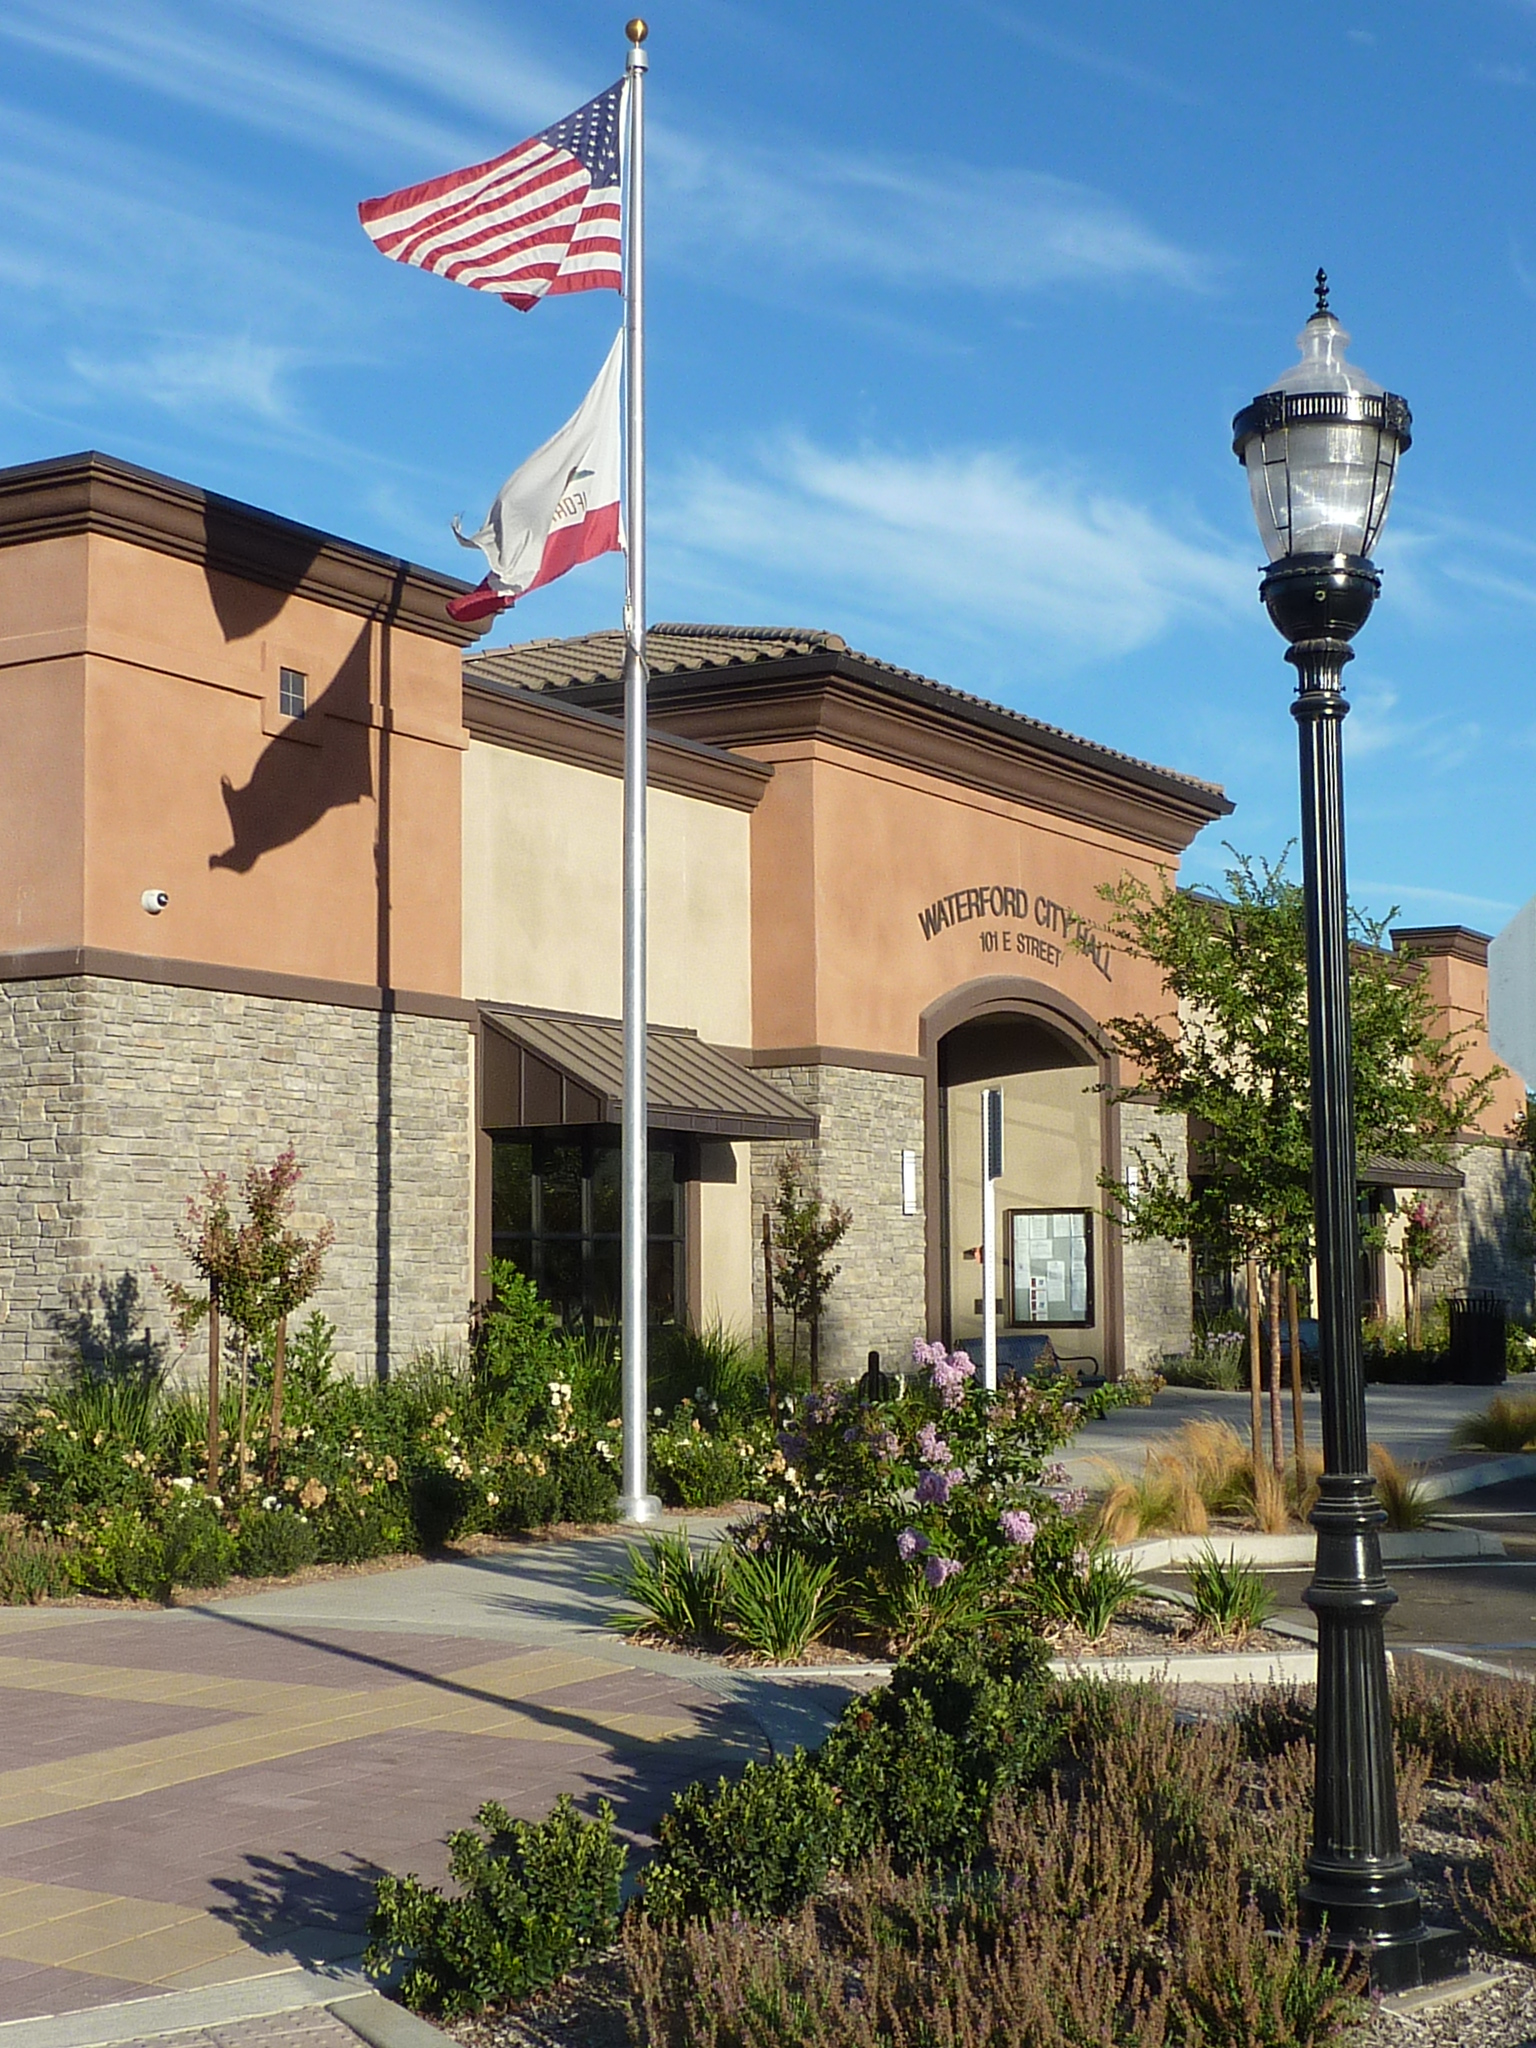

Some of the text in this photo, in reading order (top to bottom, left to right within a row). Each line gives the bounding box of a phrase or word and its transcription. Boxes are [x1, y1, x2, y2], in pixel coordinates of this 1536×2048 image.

[918, 886, 1028, 941] WATERFORD
[1034, 896, 1070, 938] CITY
[979, 930, 1062, 968] 101 E STREET
